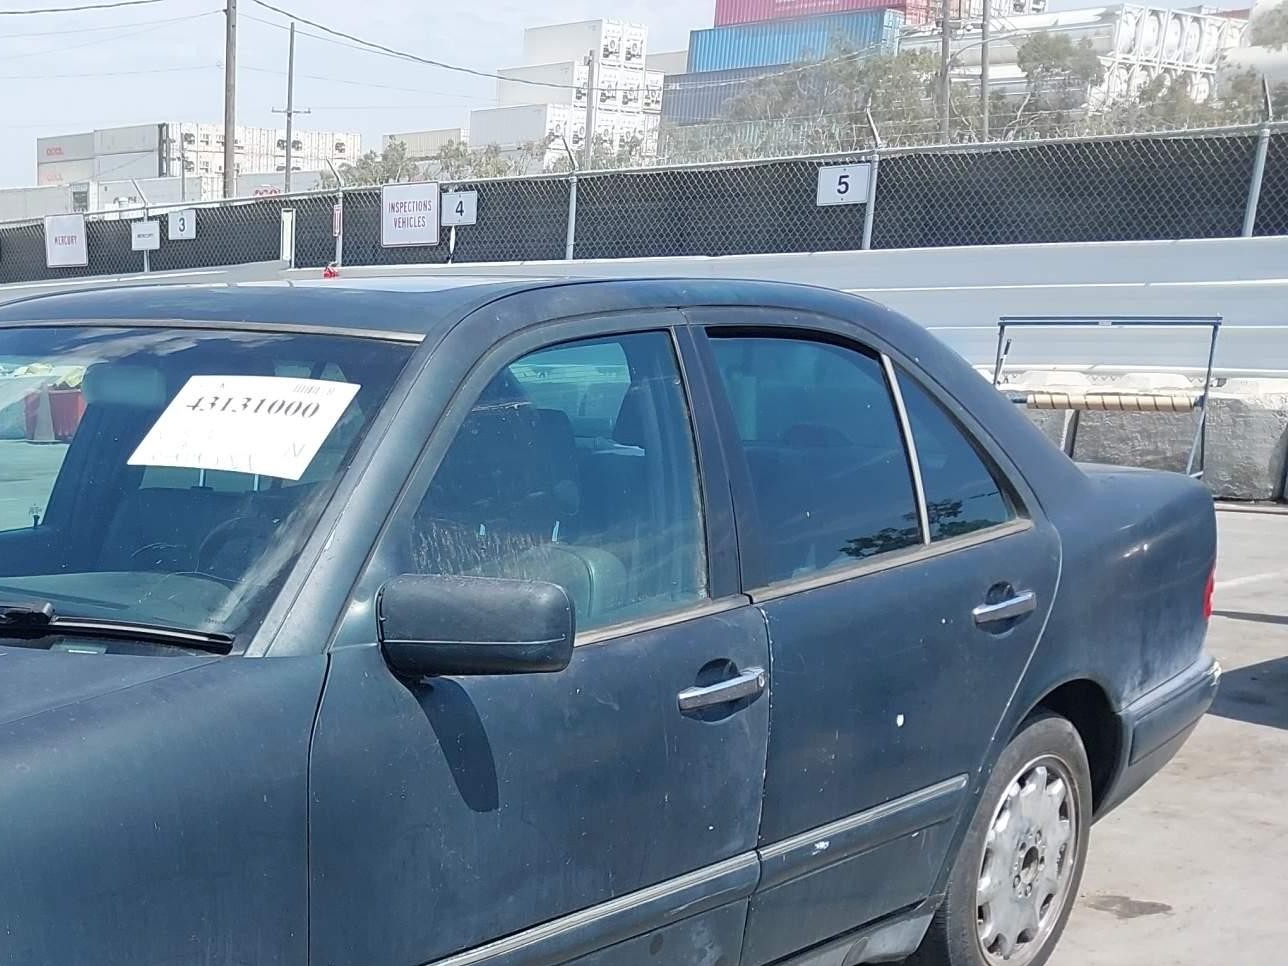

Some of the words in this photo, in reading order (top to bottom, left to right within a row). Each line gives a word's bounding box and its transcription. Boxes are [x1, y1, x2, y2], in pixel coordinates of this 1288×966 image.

[836, 174, 850, 195] 5
[388, 200, 432, 214] INSPECTIONS
[455, 200, 465, 217] 4
[178, 217, 186, 233] 3
[393, 216, 426, 229] VEHICLES
[186, 396, 320, 419] 43131000
